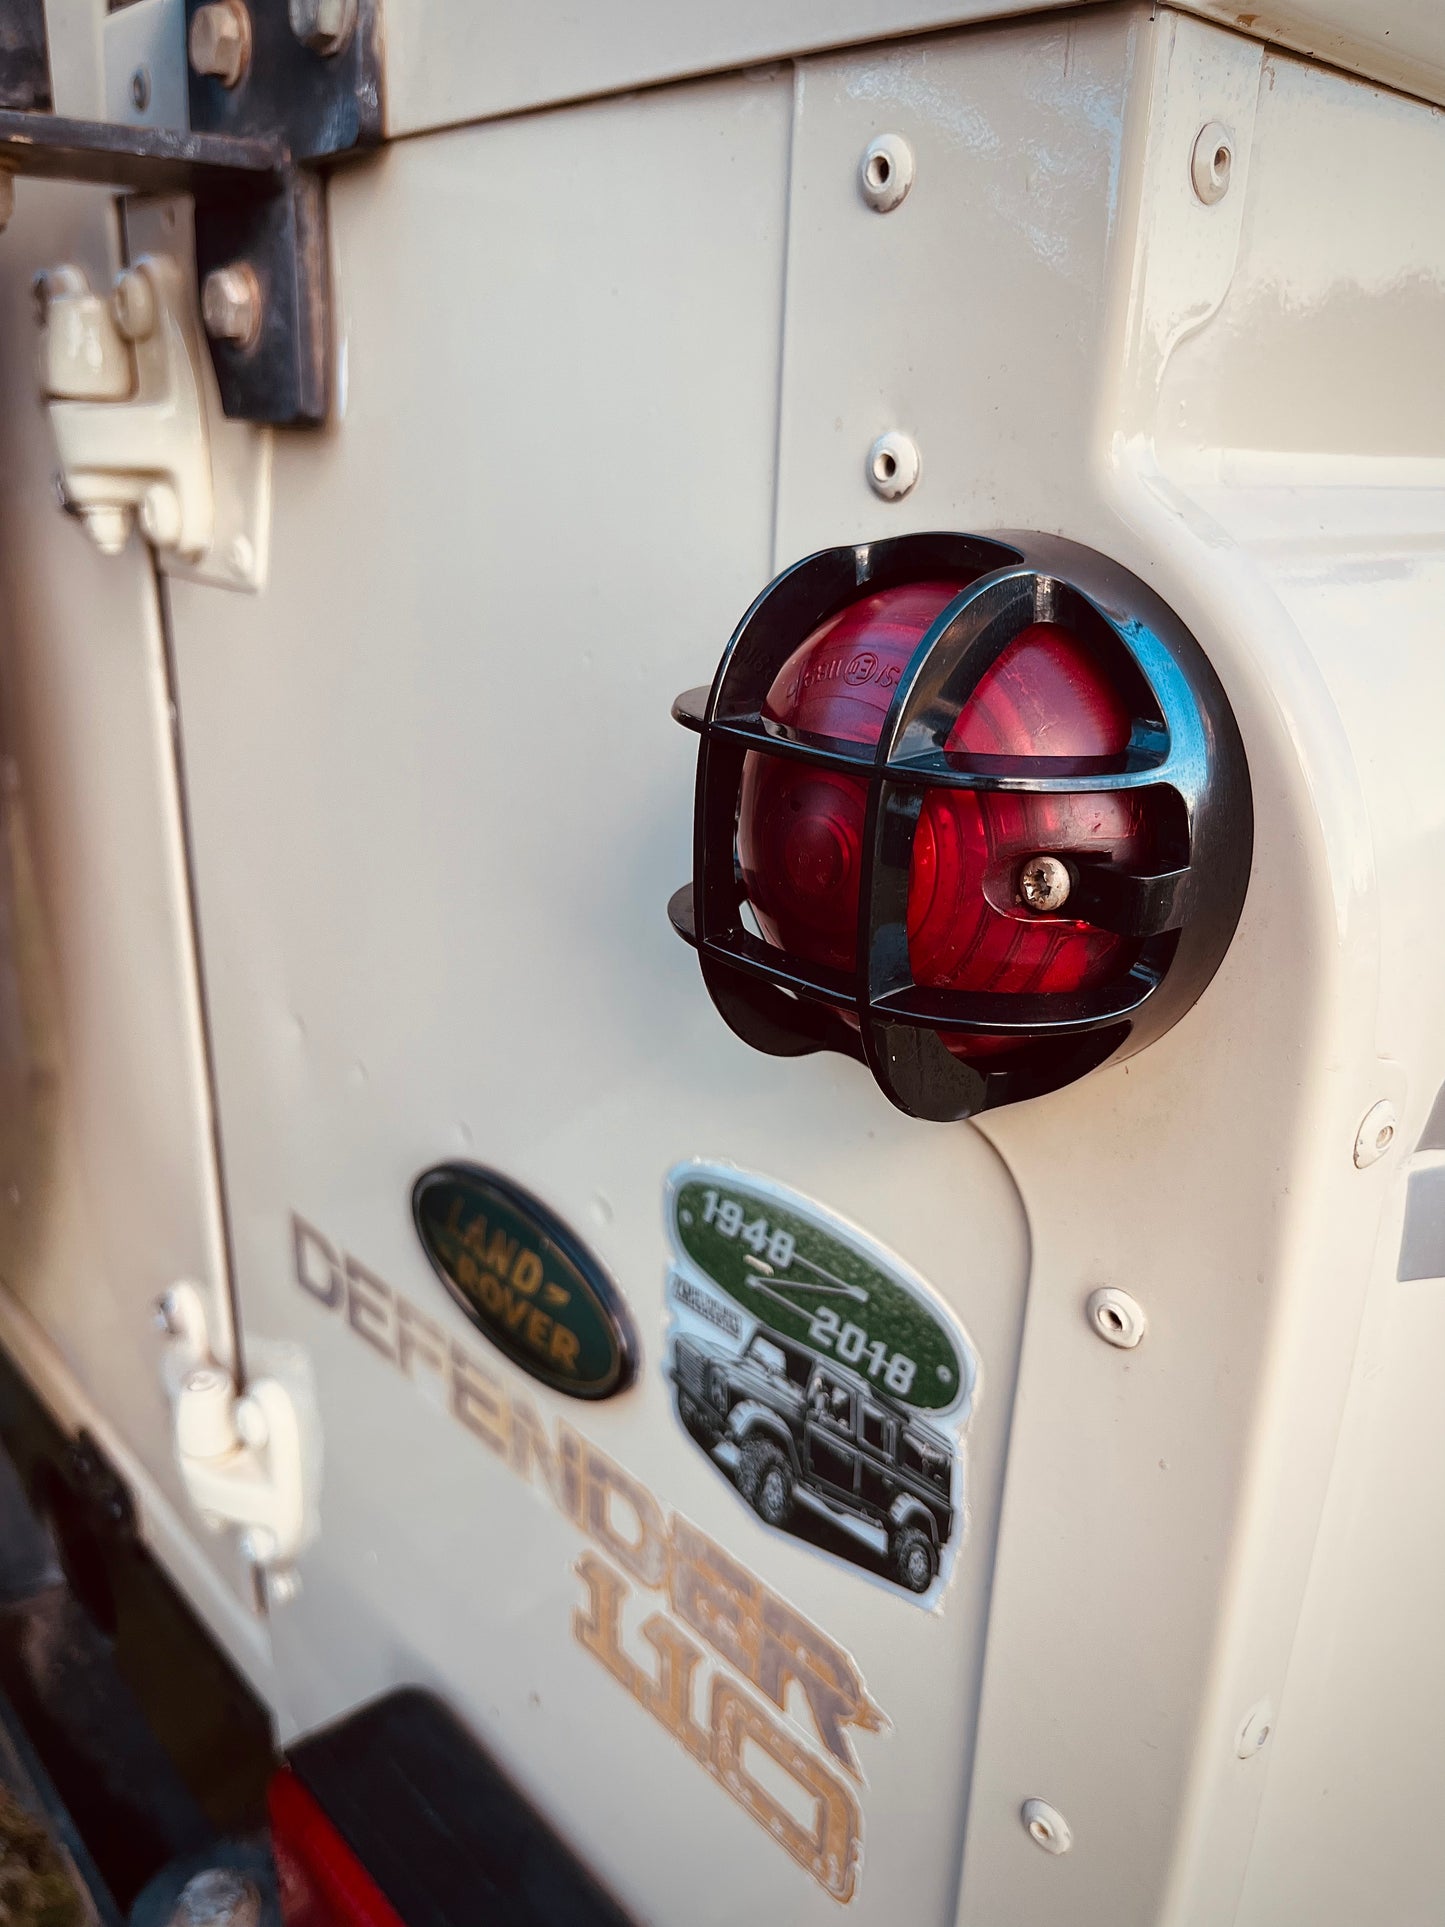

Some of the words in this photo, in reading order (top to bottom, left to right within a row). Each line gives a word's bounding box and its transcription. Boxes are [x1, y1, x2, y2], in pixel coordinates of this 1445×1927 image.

[445, 1197, 544, 1296] LAND
[702, 1190, 796, 1269] 1948
[455, 1254, 582, 1374] ROVER
[808, 1305, 918, 1395] 2018
[290, 1211, 882, 1784] DEFENDER
[572, 1550, 865, 1904] 110
